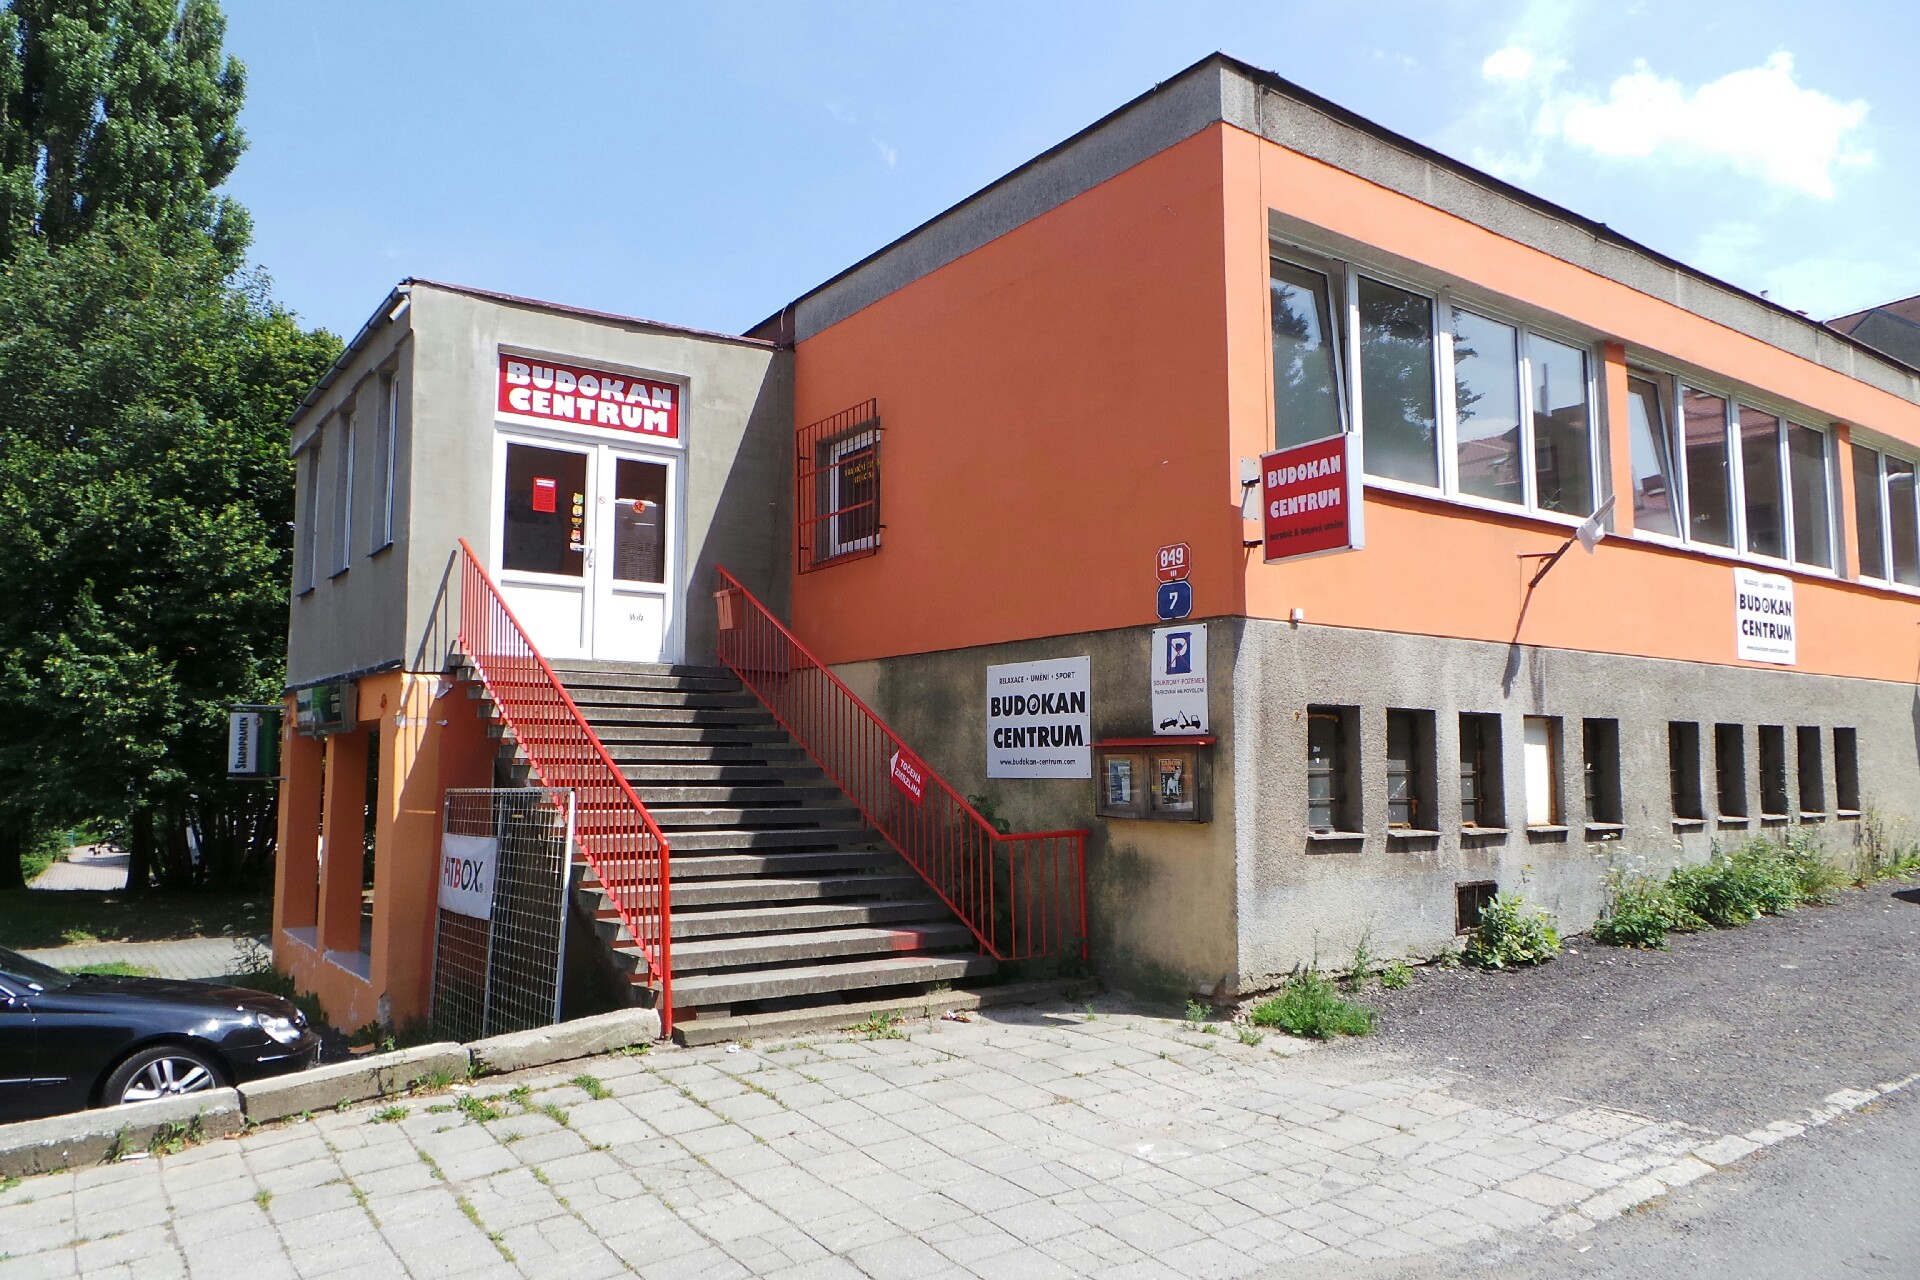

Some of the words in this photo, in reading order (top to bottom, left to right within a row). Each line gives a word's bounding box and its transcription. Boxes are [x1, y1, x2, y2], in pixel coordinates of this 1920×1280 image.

[506, 361, 672, 410] BUDOKAN
[508, 387, 668, 433] CENTRUM
[1267, 454, 1341, 489] BUDOKAN
[1270, 487, 1341, 519] CENTRUM
[1160, 546, 1184, 568] 849
[1169, 591, 1178, 610] 7
[1739, 593, 1792, 618] BUDOKAN
[1742, 619, 1793, 642] CENTRUM
[1171, 637, 1188, 668] P
[999, 675, 1024, 685] RELAXACE
[1055, 671, 1076, 681] SPORT
[990, 691, 1086, 718] BUDOKAN
[993, 724, 1084, 749] CENTRUM
[999, 757, 1076, 767] www.budokan-centrum.com
